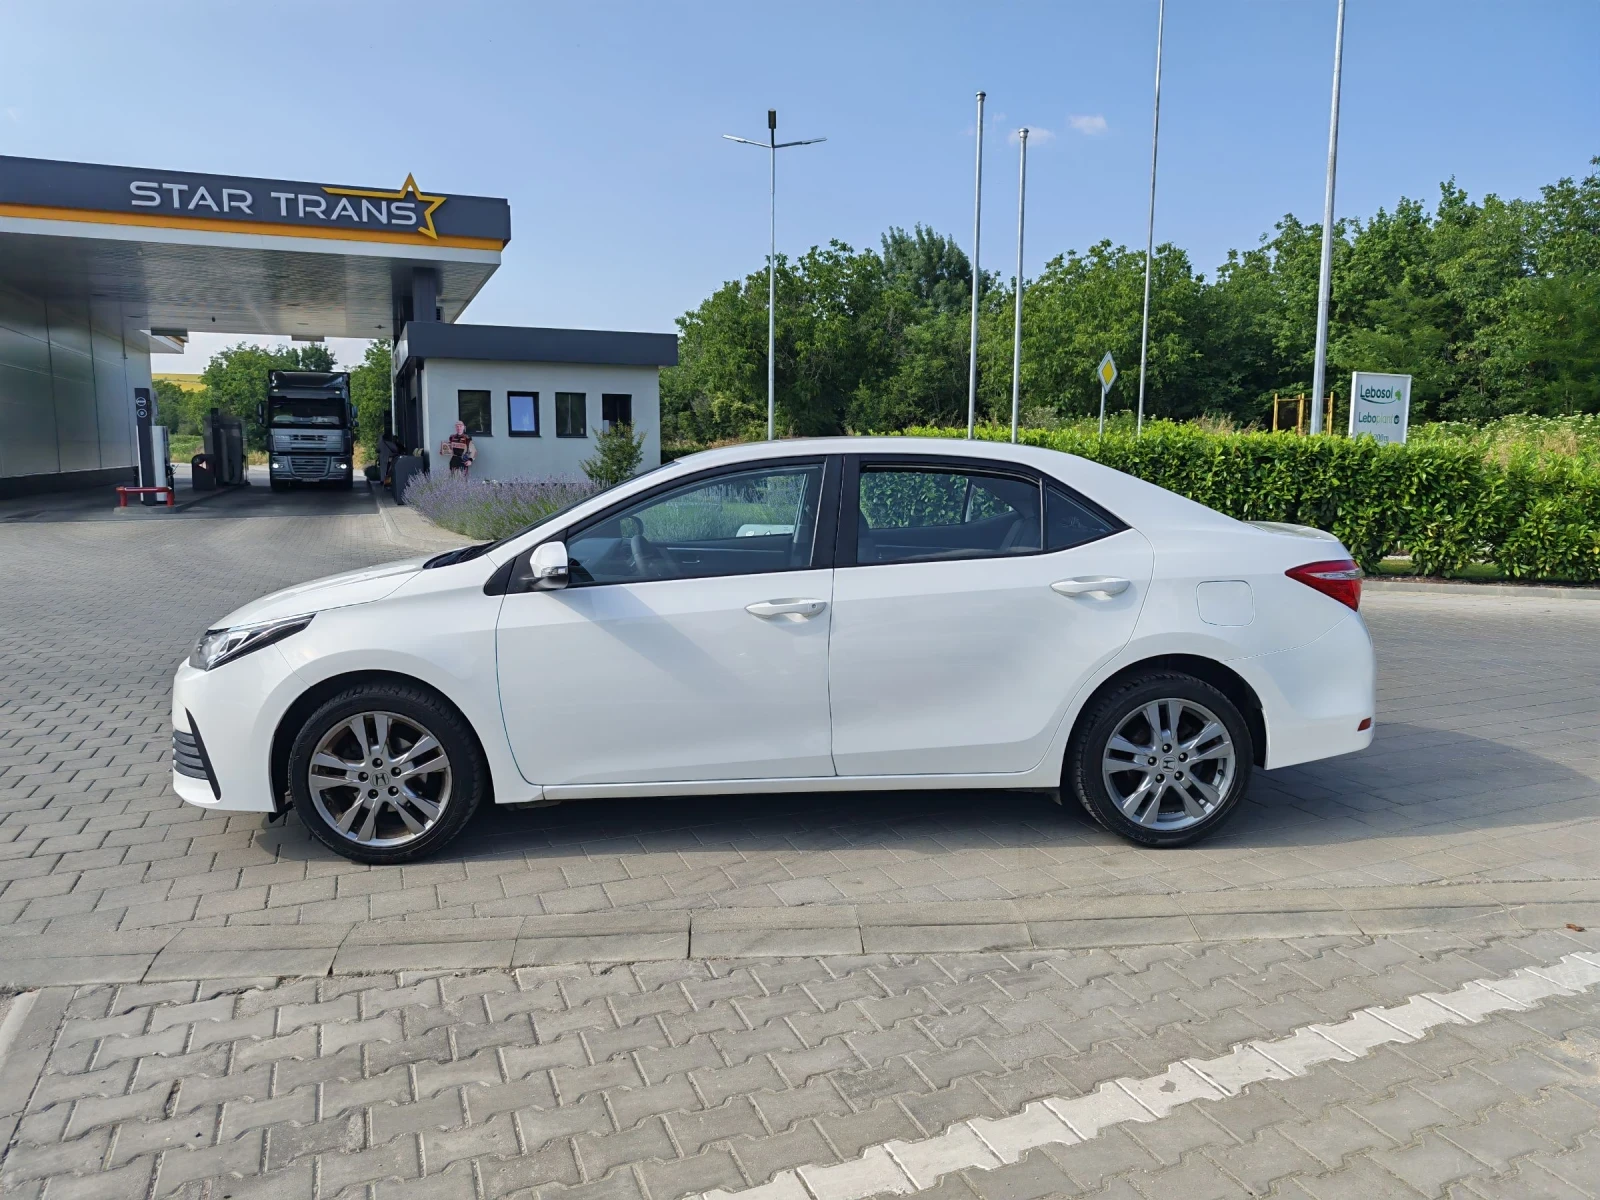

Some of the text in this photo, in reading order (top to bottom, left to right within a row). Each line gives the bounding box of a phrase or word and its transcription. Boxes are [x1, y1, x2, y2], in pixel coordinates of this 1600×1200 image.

[130, 180, 417, 226] STAR TRANS
[1360, 384, 1394, 399] Lebosol
